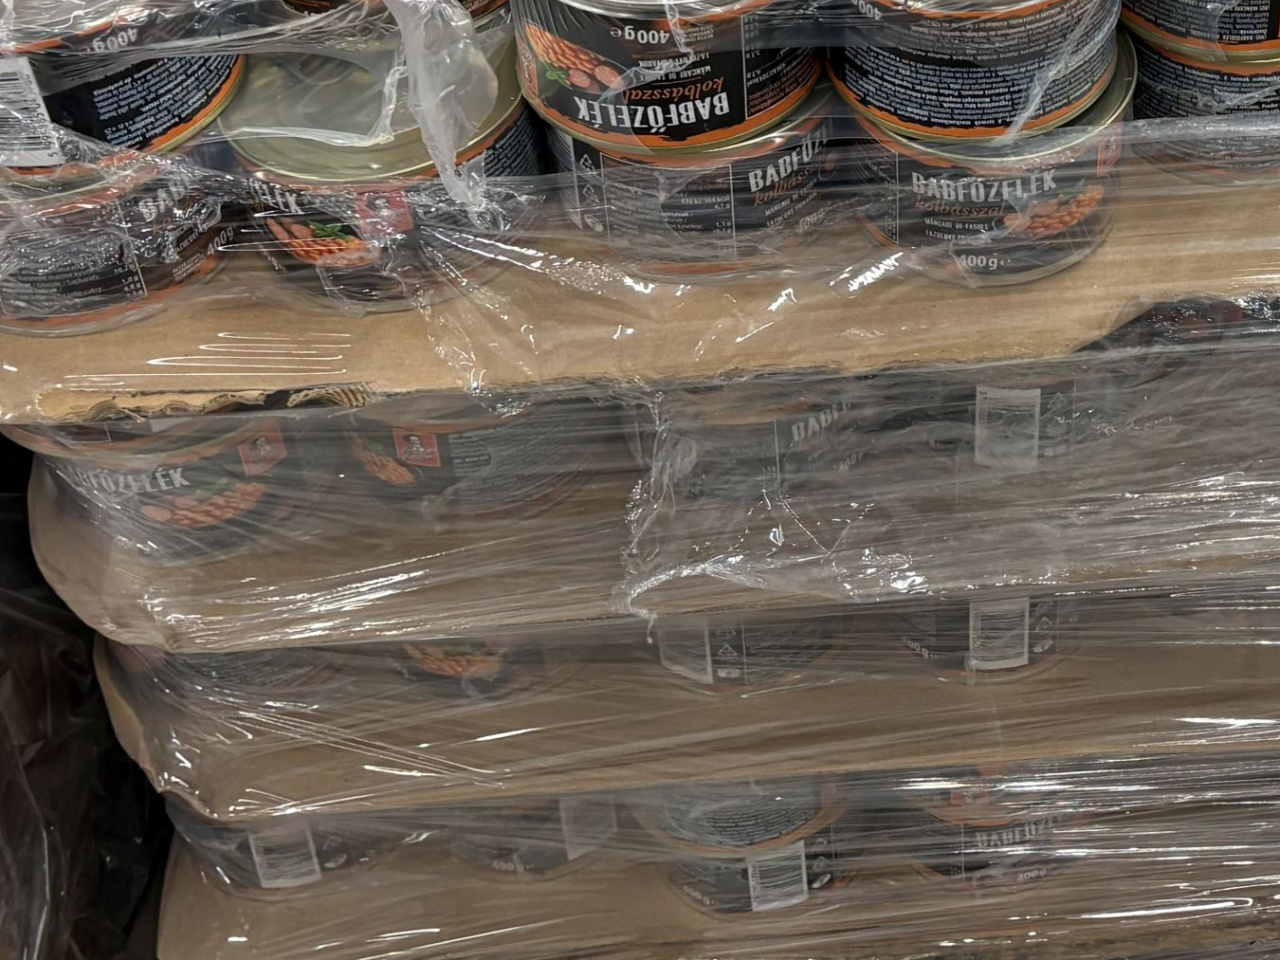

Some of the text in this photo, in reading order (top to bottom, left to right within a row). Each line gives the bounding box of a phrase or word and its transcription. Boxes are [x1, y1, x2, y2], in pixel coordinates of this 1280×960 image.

[625, 25, 670, 45] 400g
[622, 77, 724, 103] kolbásszal
[574, 91, 730, 132] BABFŐZELÉK
[914, 195, 1006, 217] kolbásszal
